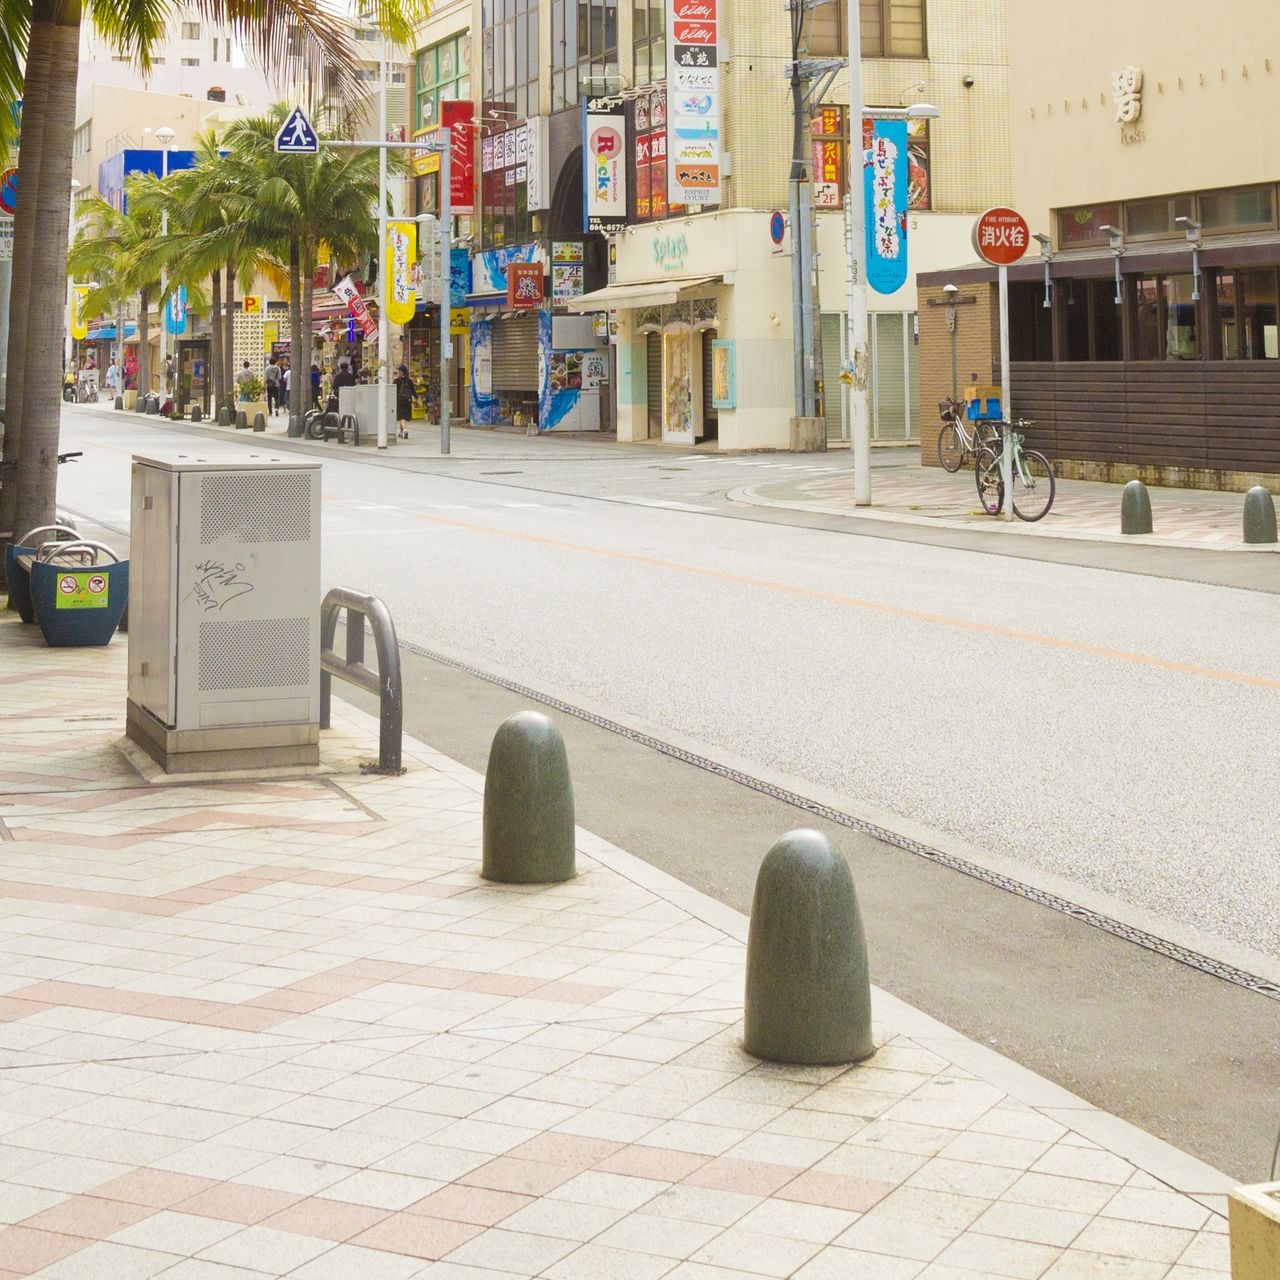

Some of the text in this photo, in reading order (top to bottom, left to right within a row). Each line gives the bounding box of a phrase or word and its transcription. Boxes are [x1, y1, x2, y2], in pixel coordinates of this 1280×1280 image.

[595, 135, 615, 203] Rocky
[822, 193, 836, 204] 2F
[981, 225, 1024, 247] 消火栓
[570, 266, 582, 276] 2F
[245, 298, 257, 312] P
